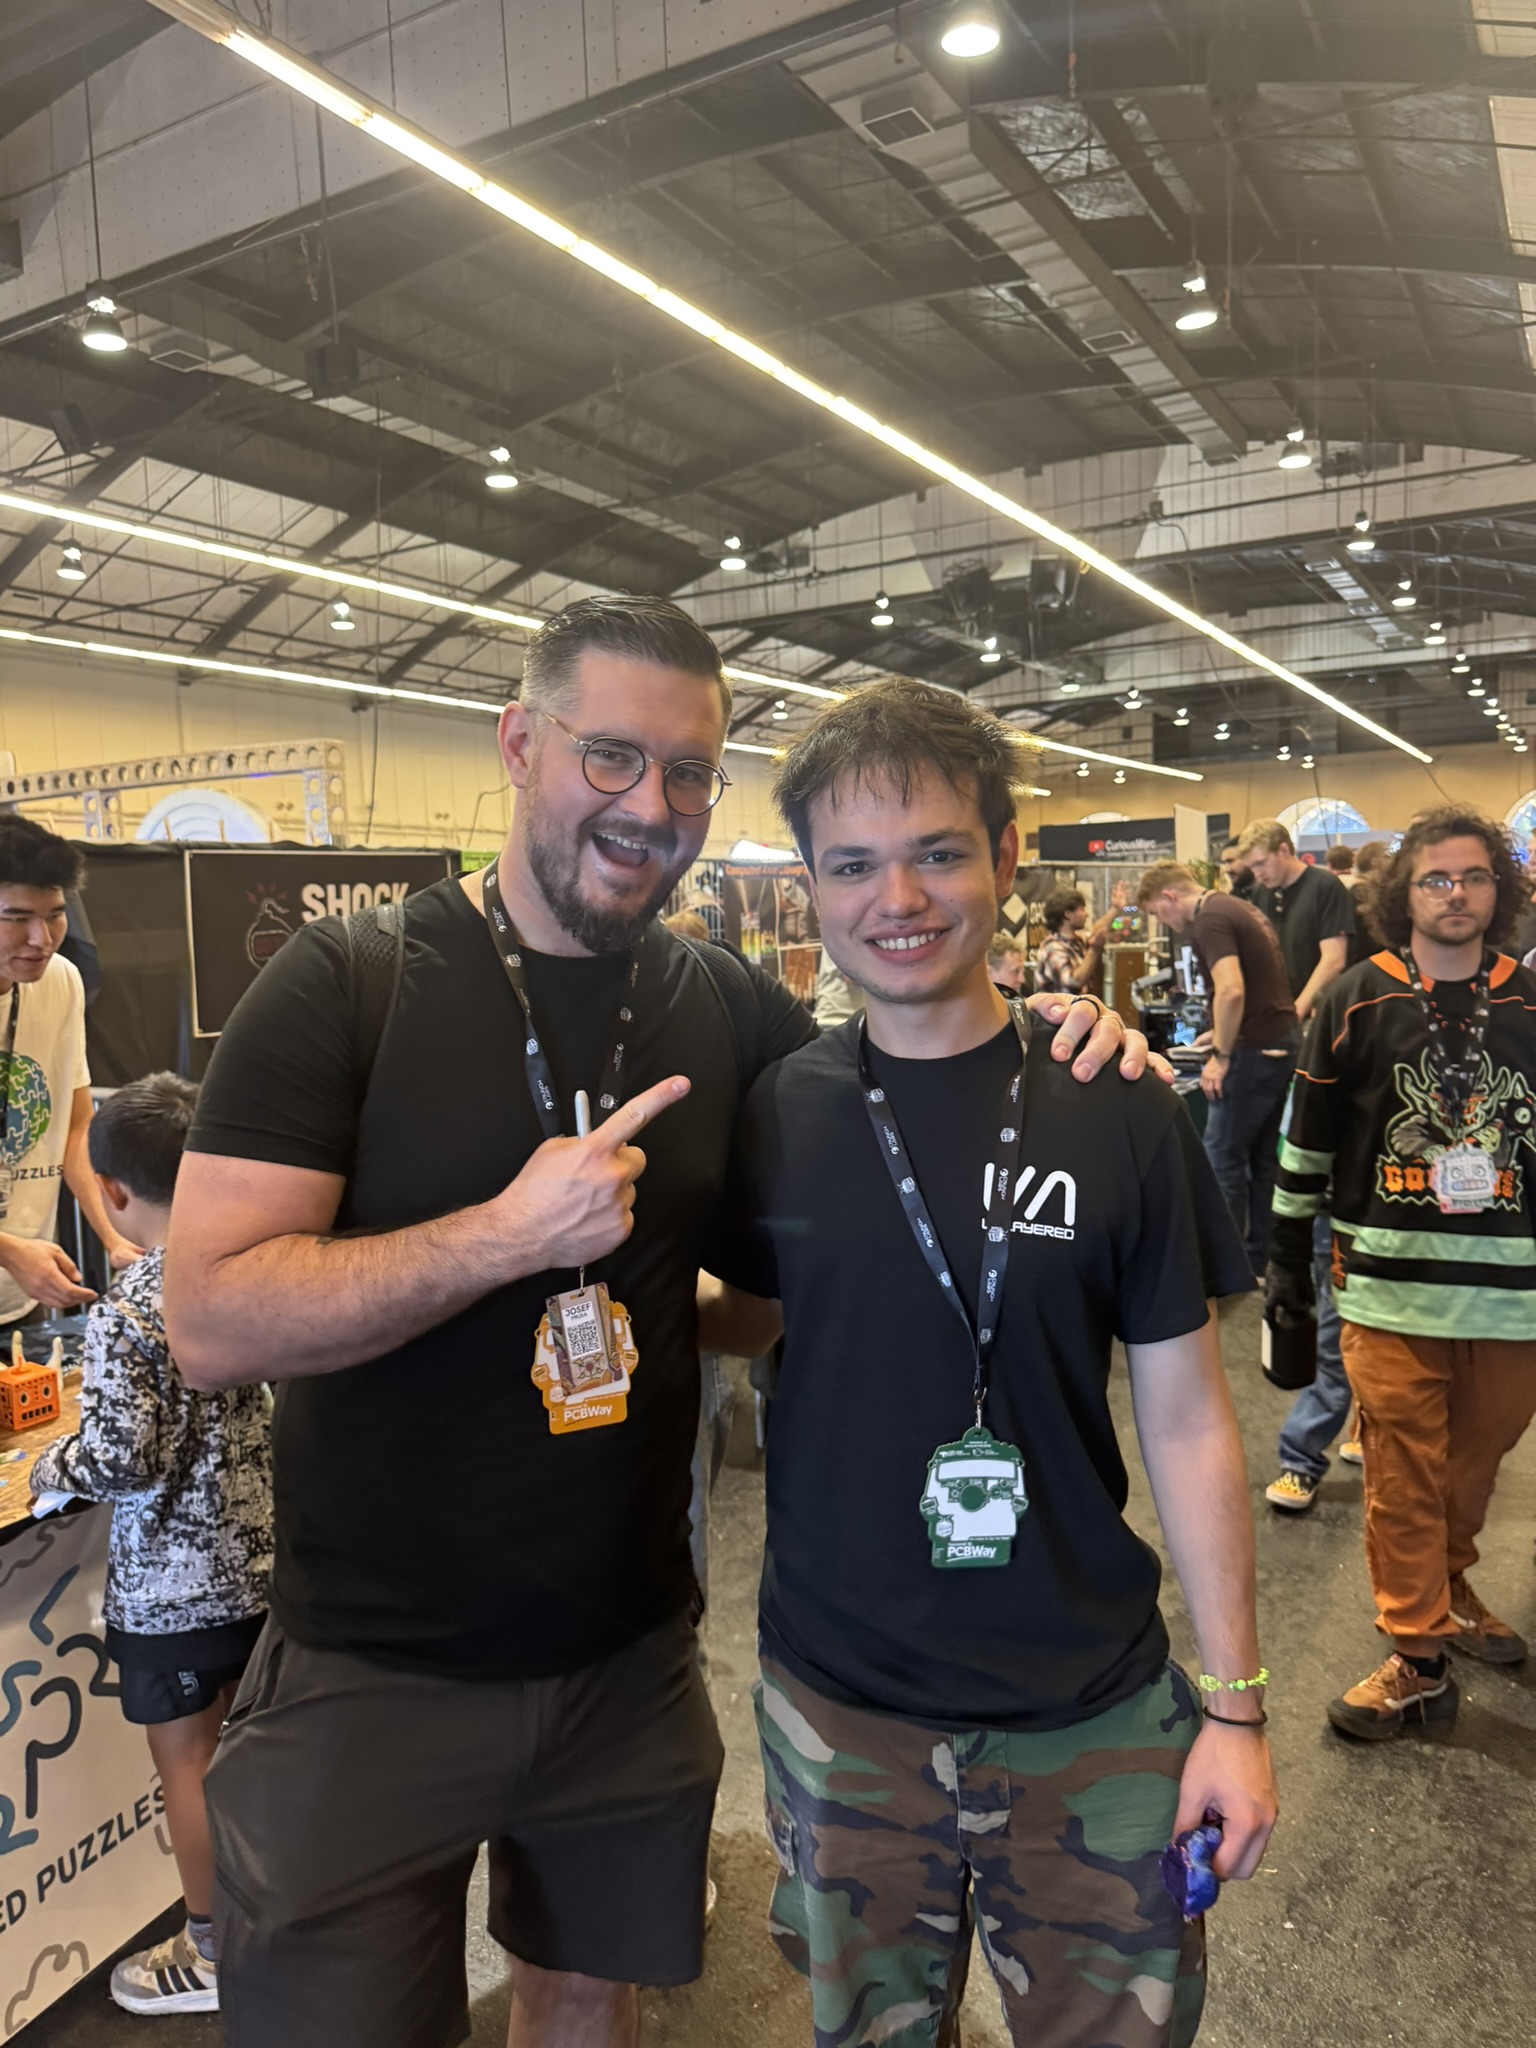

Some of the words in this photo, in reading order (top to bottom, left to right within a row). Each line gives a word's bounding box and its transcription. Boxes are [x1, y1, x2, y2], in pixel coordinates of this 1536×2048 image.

[302, 882, 409, 923] SHOCK
[13, 1164, 64, 1181] UZZLES
[981, 1217, 1075, 1241] AYERED
[565, 1302, 591, 1317] JOSEF
[563, 1404, 613, 1423] PCBWay
[947, 1545, 997, 1559] PCBWay
[36, 1785, 166, 1904] PUZZLES
